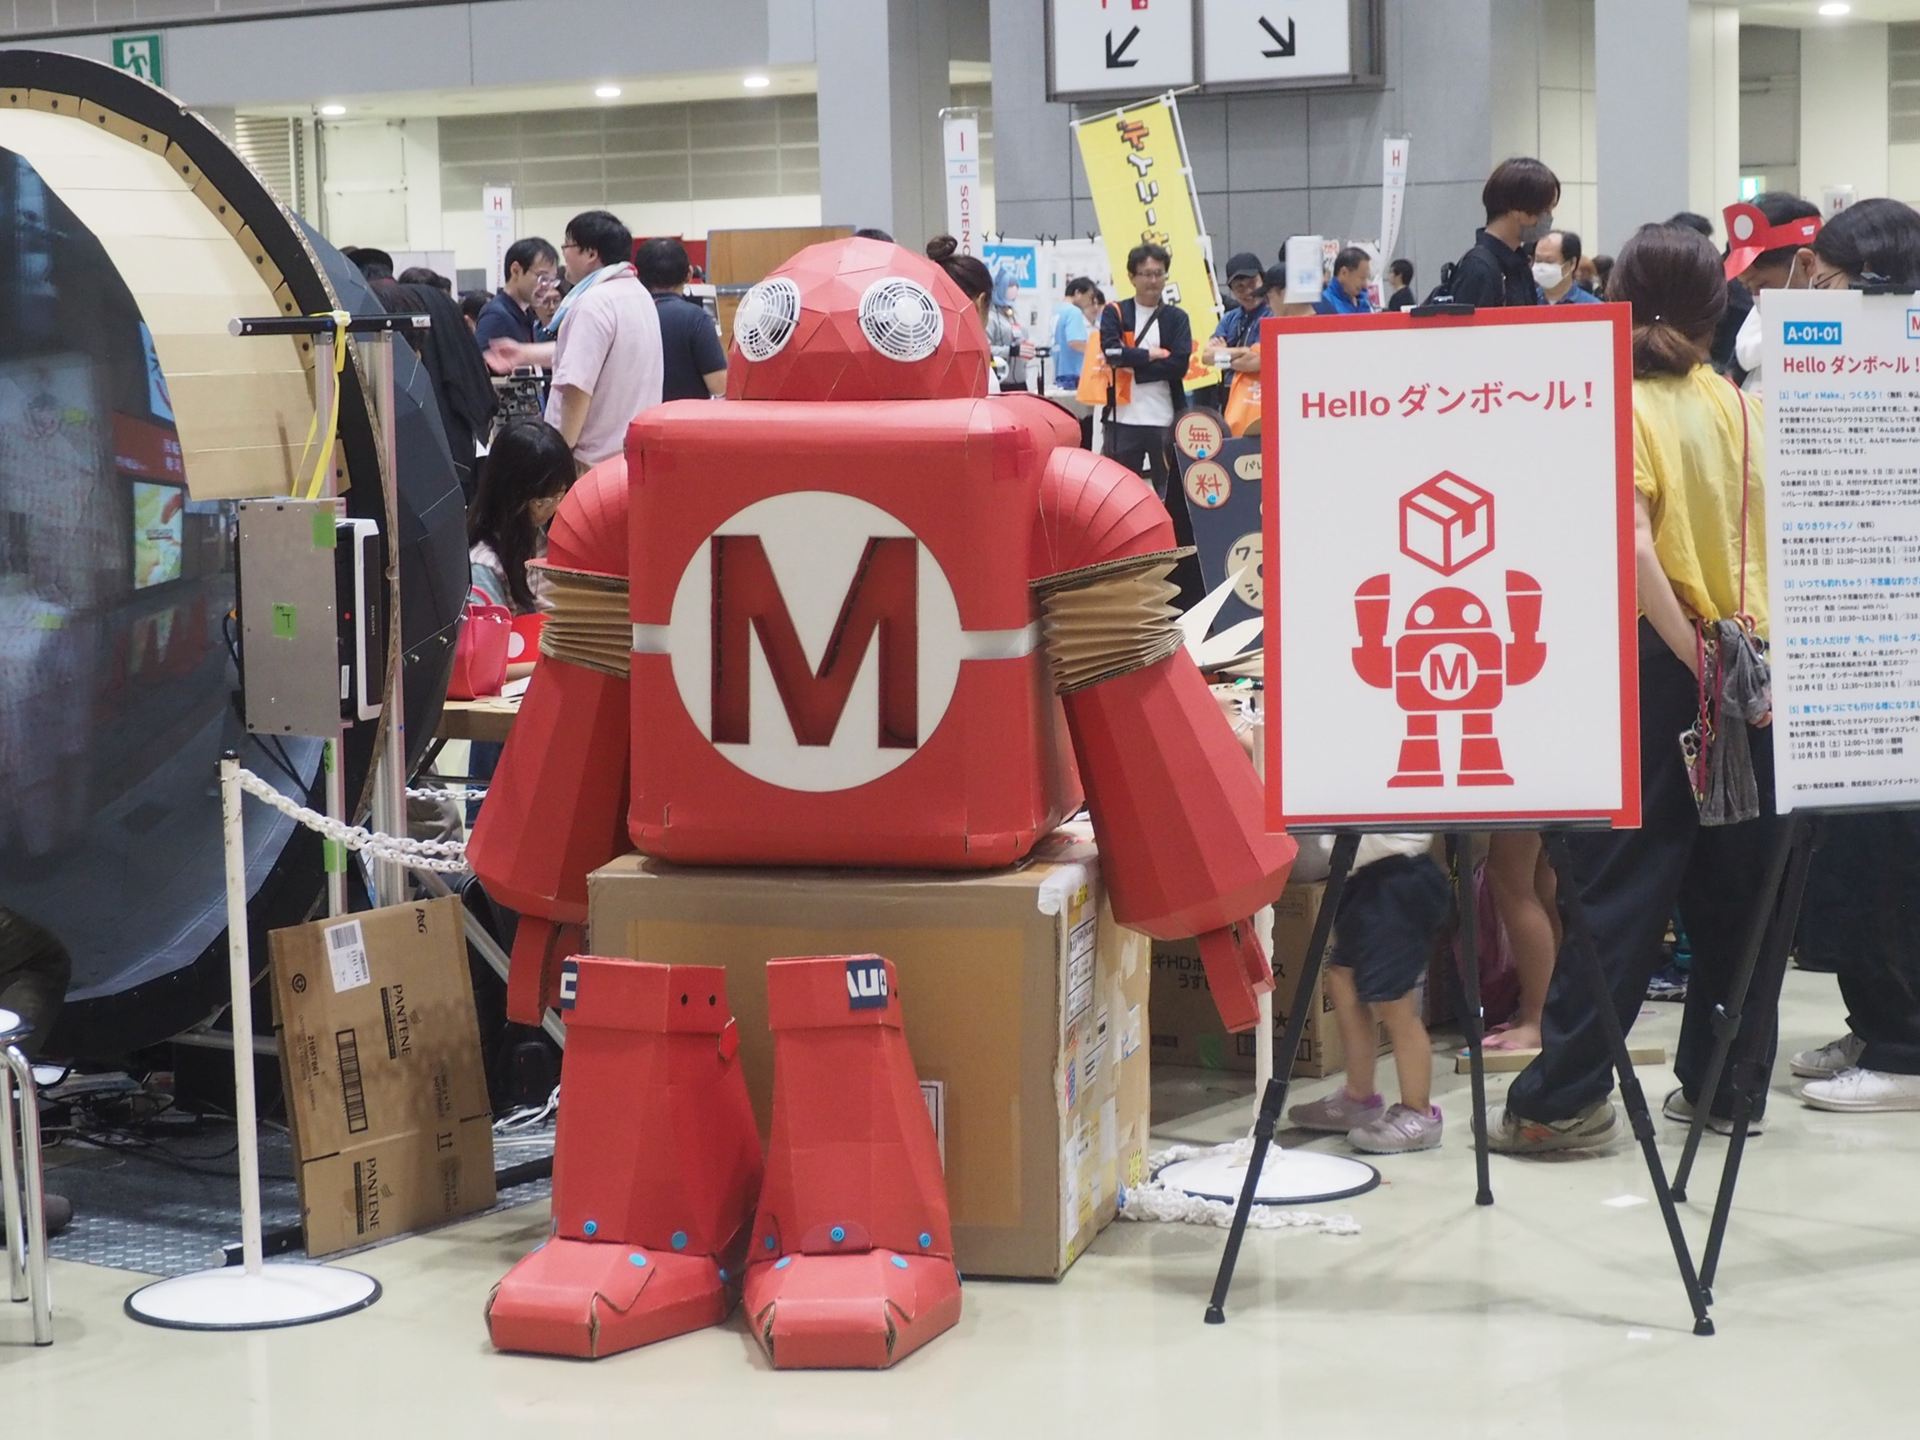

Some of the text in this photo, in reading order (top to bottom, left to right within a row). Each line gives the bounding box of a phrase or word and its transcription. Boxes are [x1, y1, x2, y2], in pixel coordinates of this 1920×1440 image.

[1392, 151, 1401, 167] H
[494, 196, 502, 210] H
[961, 185, 971, 257] SCIENC
[1784, 357, 1826, 373] Hello
[1302, 390, 1390, 418] Hello
[711, 535, 918, 748] M
[1430, 653, 1468, 690] M
[416, 908, 428, 934] P&G
[393, 984, 411, 1056] PANTENE
[367, 1157, 380, 1231] PANTENE
